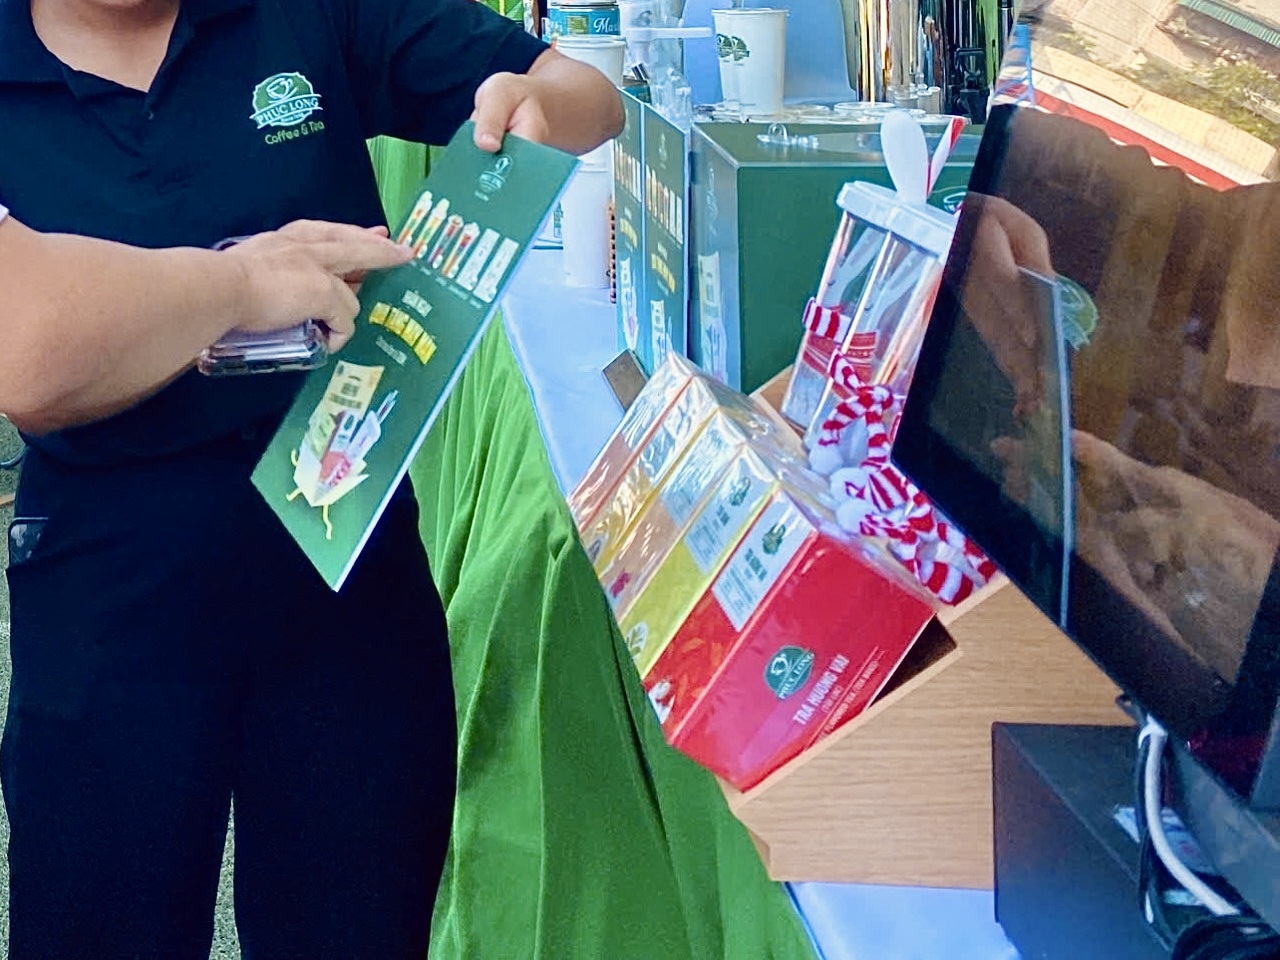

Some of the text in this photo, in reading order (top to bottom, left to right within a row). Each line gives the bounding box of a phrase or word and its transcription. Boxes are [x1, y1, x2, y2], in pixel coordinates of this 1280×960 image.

[289, 97, 319, 111] LONG
[264, 121, 325, 145] Coffee & Tea
